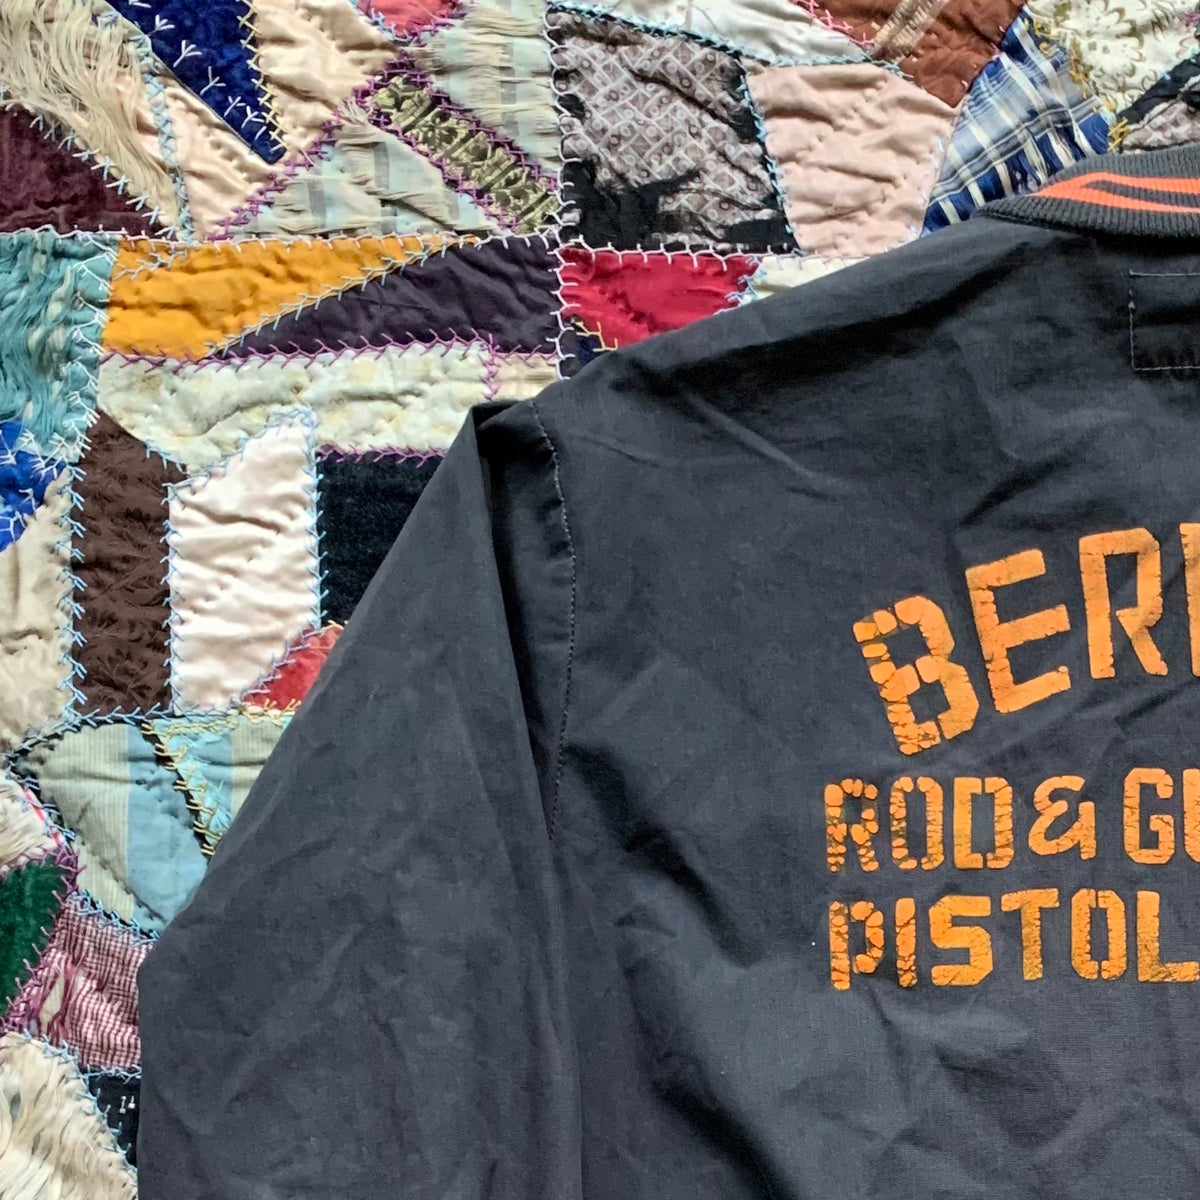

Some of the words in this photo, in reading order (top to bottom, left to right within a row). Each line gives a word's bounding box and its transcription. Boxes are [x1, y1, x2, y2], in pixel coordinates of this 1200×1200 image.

[823, 775, 1015, 872] ROD
[1027, 775, 1097, 861] &
[828, 887, 1200, 992] PISTOL
